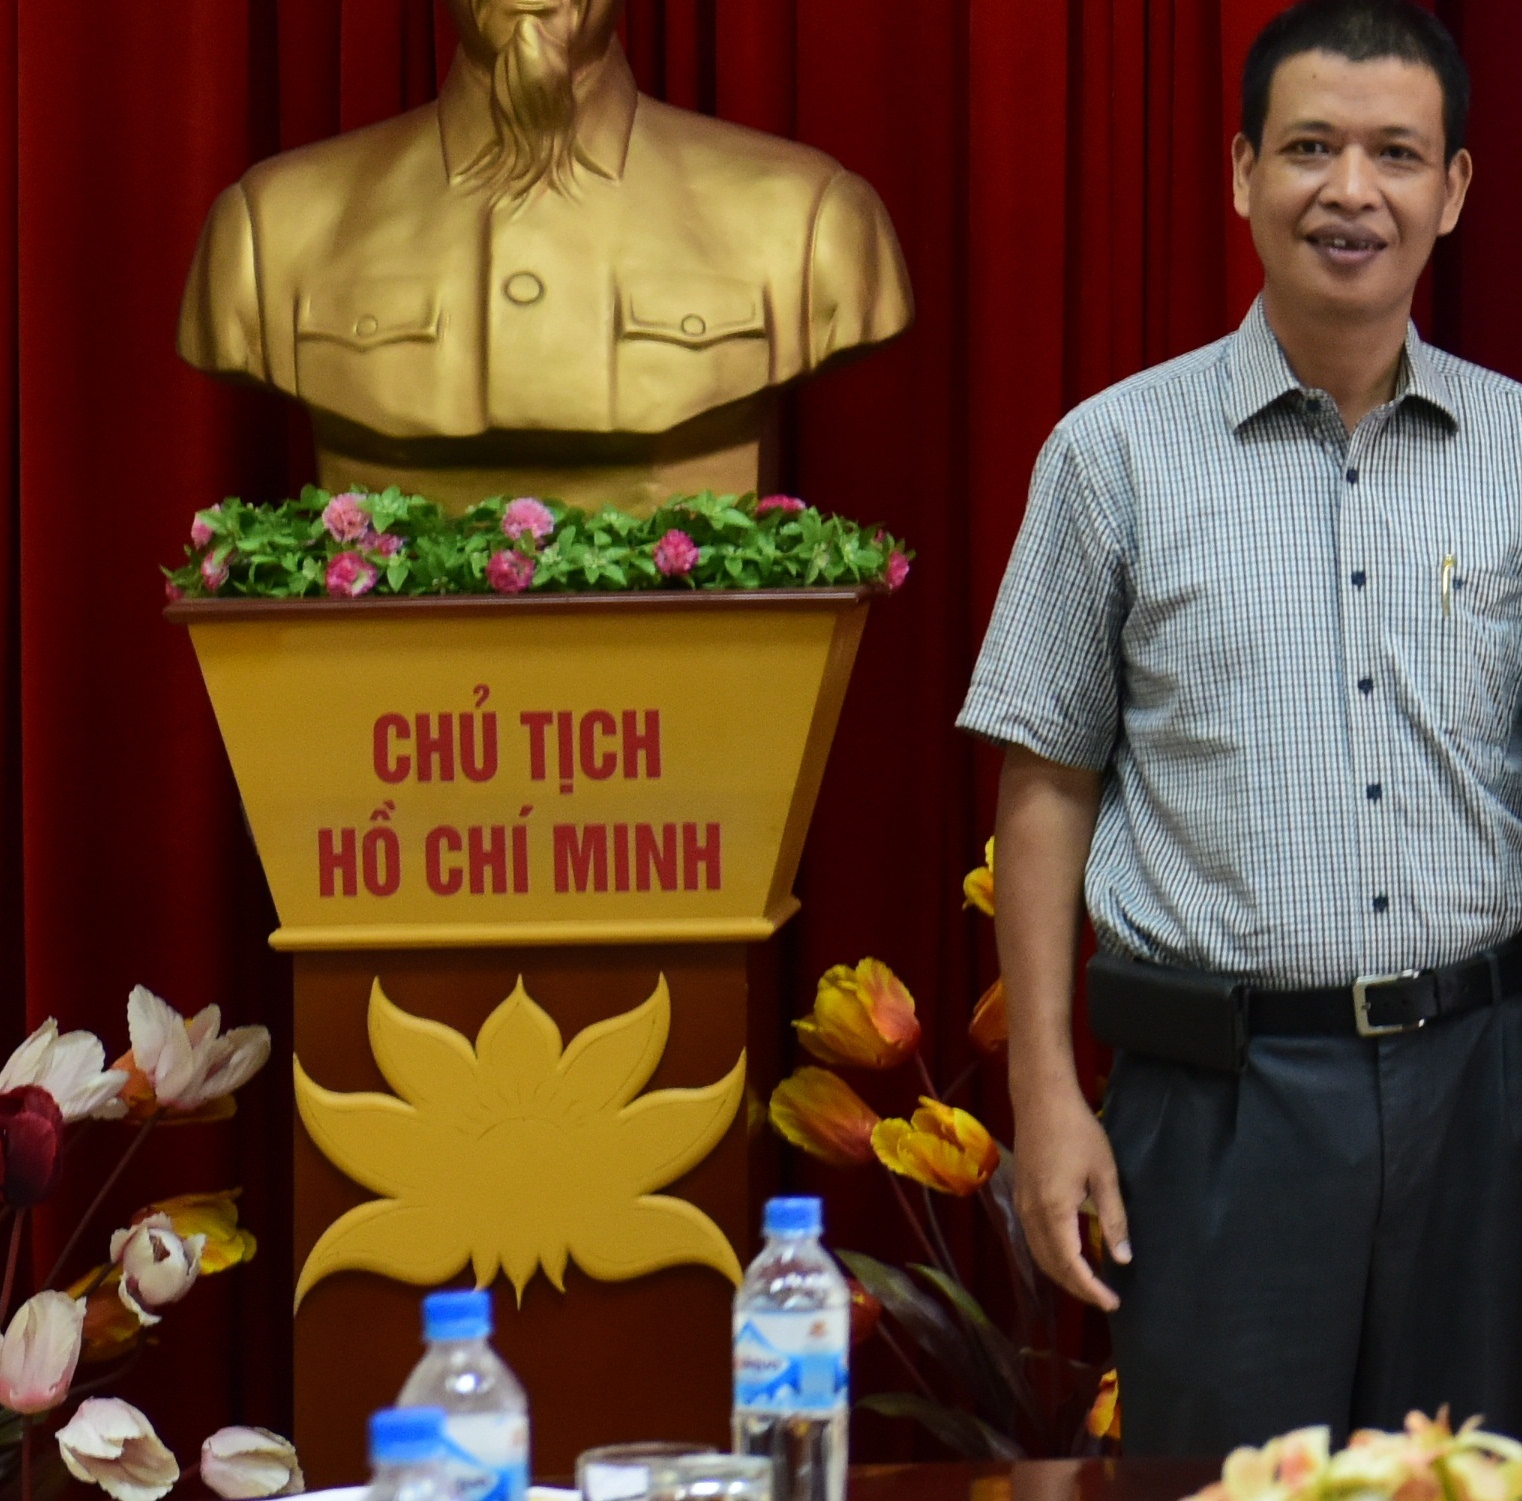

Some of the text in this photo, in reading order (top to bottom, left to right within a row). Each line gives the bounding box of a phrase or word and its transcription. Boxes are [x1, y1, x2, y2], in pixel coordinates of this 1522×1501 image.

[373, 684, 662, 795] CHỦ TỊCH
[317, 800, 722, 898] HỒ CHÍ MINH
